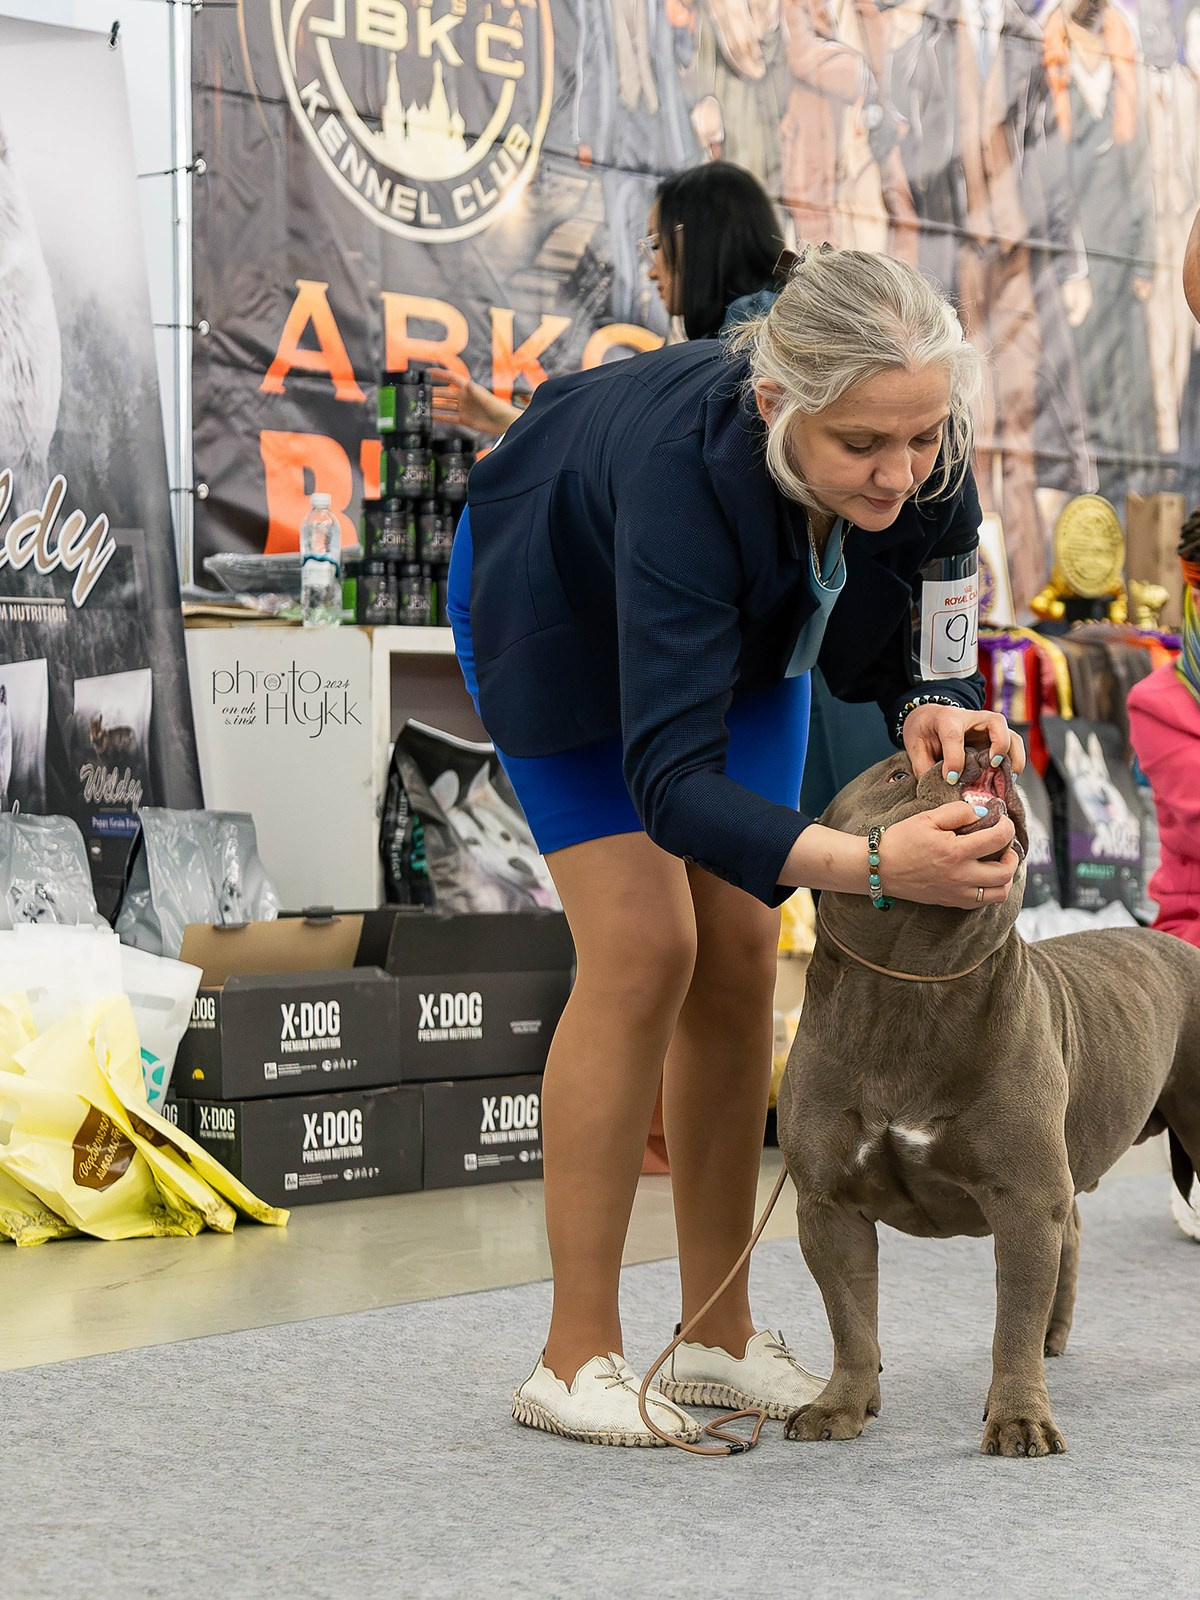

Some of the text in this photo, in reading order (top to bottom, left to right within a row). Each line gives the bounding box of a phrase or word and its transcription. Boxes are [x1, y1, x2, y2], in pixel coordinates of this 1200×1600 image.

[300, 79, 531, 225] KENNEL CLUB
[945, 595, 967, 606] ROYAL
[9, 605, 67, 622] NUTRITION
[192, 997, 216, 1021] DOG
